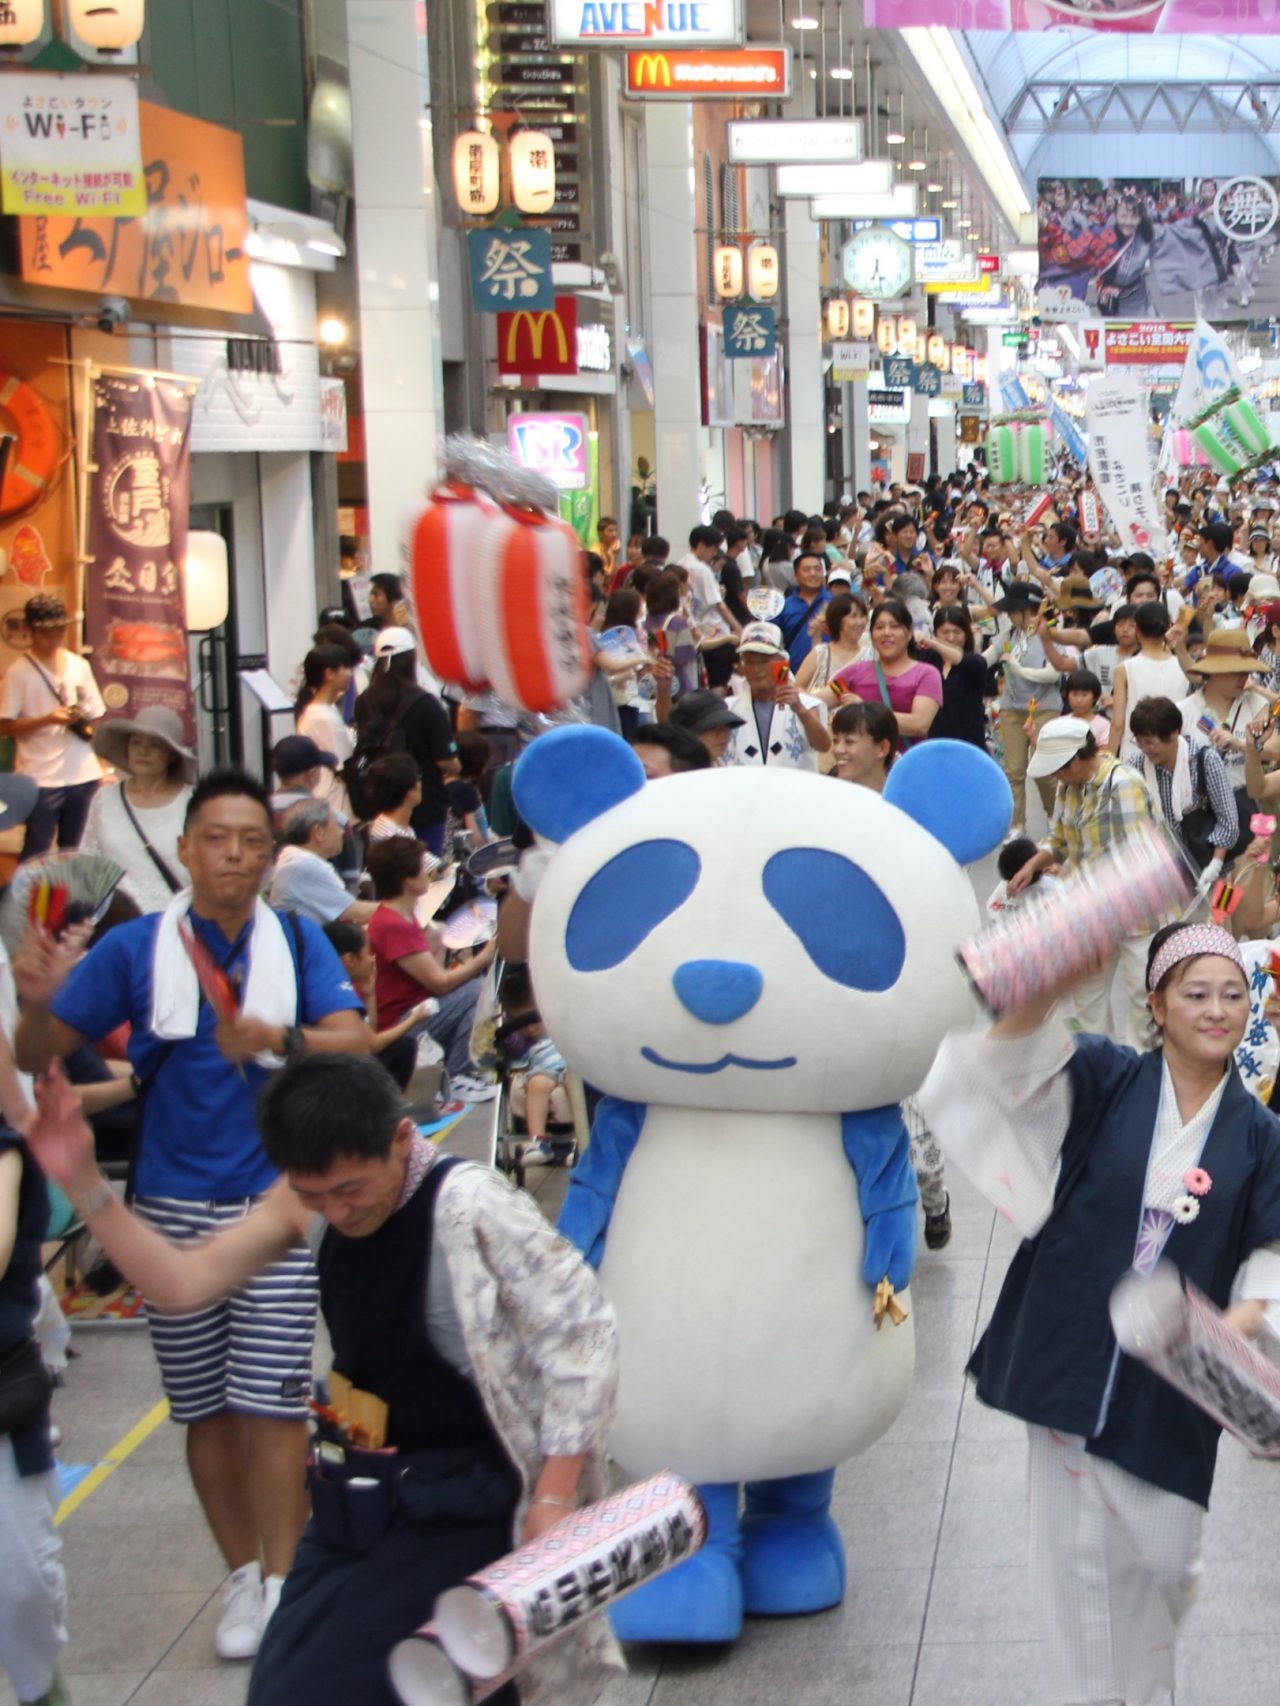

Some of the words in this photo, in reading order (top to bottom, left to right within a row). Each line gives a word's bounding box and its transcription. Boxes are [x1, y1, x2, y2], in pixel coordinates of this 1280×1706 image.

[580, 0, 711, 36] AVENUE
[24, 112, 112, 141] Wi-Fi
[24, 190, 65, 206] Free
[1225, 183, 1268, 236] 舞
[480, 238, 545, 299] 祭
[730, 311, 769, 351] 祭
